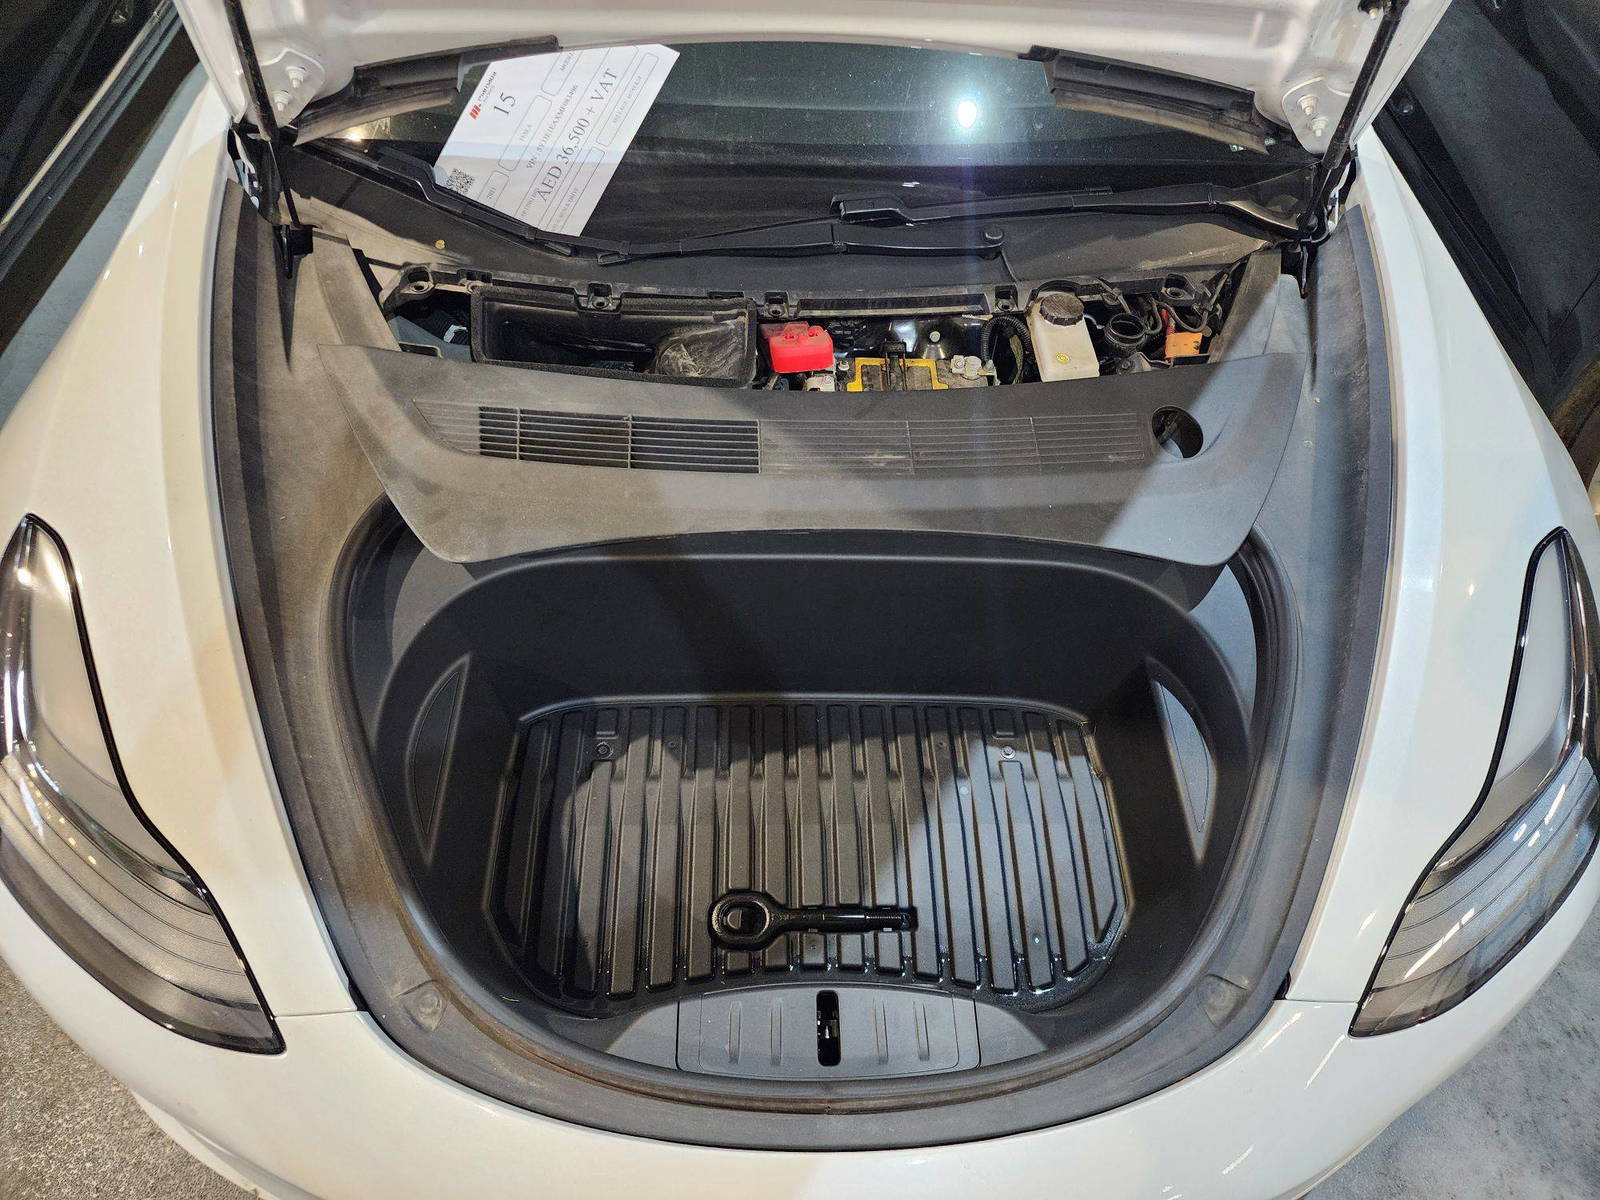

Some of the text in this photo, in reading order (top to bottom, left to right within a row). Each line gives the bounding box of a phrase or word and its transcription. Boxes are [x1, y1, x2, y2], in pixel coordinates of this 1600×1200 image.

[494, 92, 516, 115] 15
[537, 166, 562, 203] AED
[556, 118, 590, 165] 36,500
[591, 68, 617, 100] VAT
